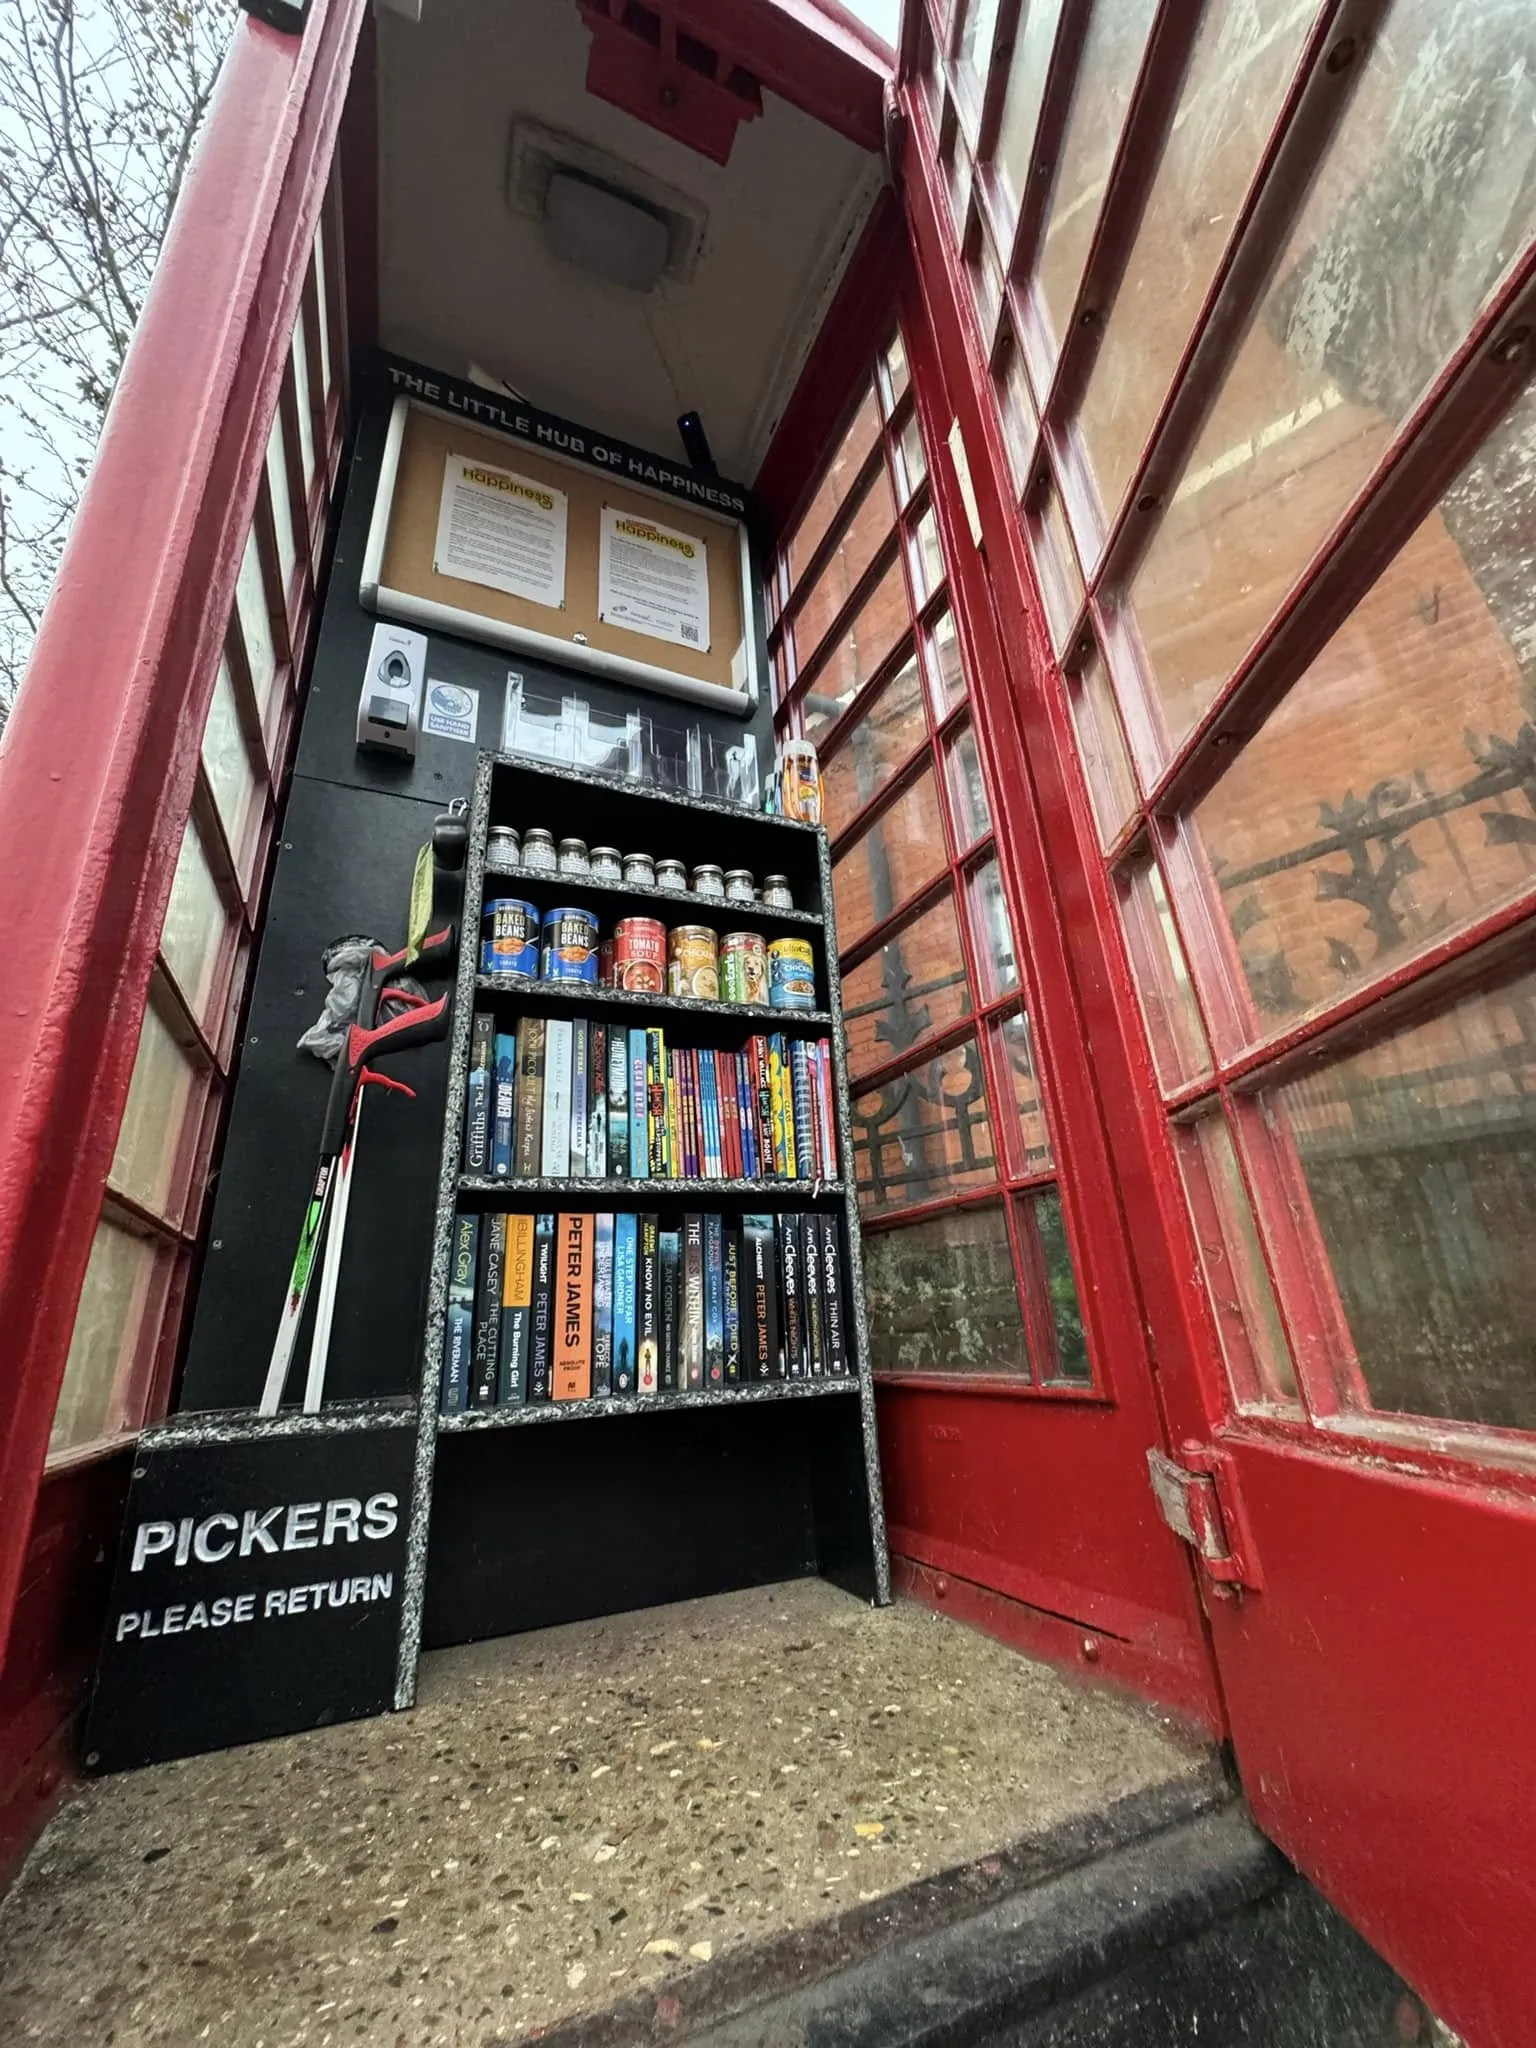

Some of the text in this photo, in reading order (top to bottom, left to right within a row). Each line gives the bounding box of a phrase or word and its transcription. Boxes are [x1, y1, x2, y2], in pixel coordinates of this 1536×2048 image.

[388, 367, 744, 512] THE LITTLE HUB OF HAPPINESS
[463, 467, 553, 510] Happiness
[616, 519, 694, 558] Happiness
[494, 924, 526, 938] BEANS
[495, 912, 526, 926] BAKED
[560, 933, 589, 947] BEANS
[561, 921, 589, 936] BAKED
[628, 938, 660, 953] TOMATO
[525, 1028, 537, 1093] JODI PICOULT
[474, 1091, 484, 1107] The
[497, 1082, 513, 1118] DEAVER
[469, 1111, 485, 1167] Griffiths
[454, 1220, 473, 1285] Alex Gray
[487, 1218, 500, 1295] JANE CASEY
[688, 1221, 700, 1245] THE
[728, 1241, 736, 1269] JUST
[513, 1221, 528, 1301] BILLINGHAM
[539, 1243, 548, 1284] TWILIGHT
[565, 1217, 583, 1348] PETER JAMES
[616, 1246, 625, 1314] LISA GARDNER
[625, 1258, 633, 1282] STEP
[755, 1238, 764, 1280] ALCHEMIST
[784, 1244, 797, 1296] Cleeves
[806, 1226, 819, 1295] Ann Cleeves
[824, 1226, 837, 1294] Ann Cleeves
[625, 1285, 633, 1303] TOO
[644, 1257, 653, 1337] KNOW NO EVIL
[664, 1285, 673, 1322] COBEN
[688, 1276, 700, 1324] WITHIN
[729, 1270, 737, 1315] BEFORE
[476, 1321, 489, 1361] PLACE
[485, 1301, 499, 1381] THE CUTTING
[534, 1293, 548, 1377] PETER JAMES
[730, 1323, 738, 1351] DIED
[756, 1284, 768, 1360] PETER JAMES
[788, 1298, 798, 1359] WHITE NIGHTS
[829, 1300, 840, 1349] THIN AIR
[450, 1317, 463, 1384] THE RIVERMAN
[510, 1312, 522, 1388] The Burning Girl
[595, 1335, 605, 1369] TOPE
[130, 1492, 399, 1573] PICKERS
[115, 1572, 393, 1643] PLEASE RETURN
